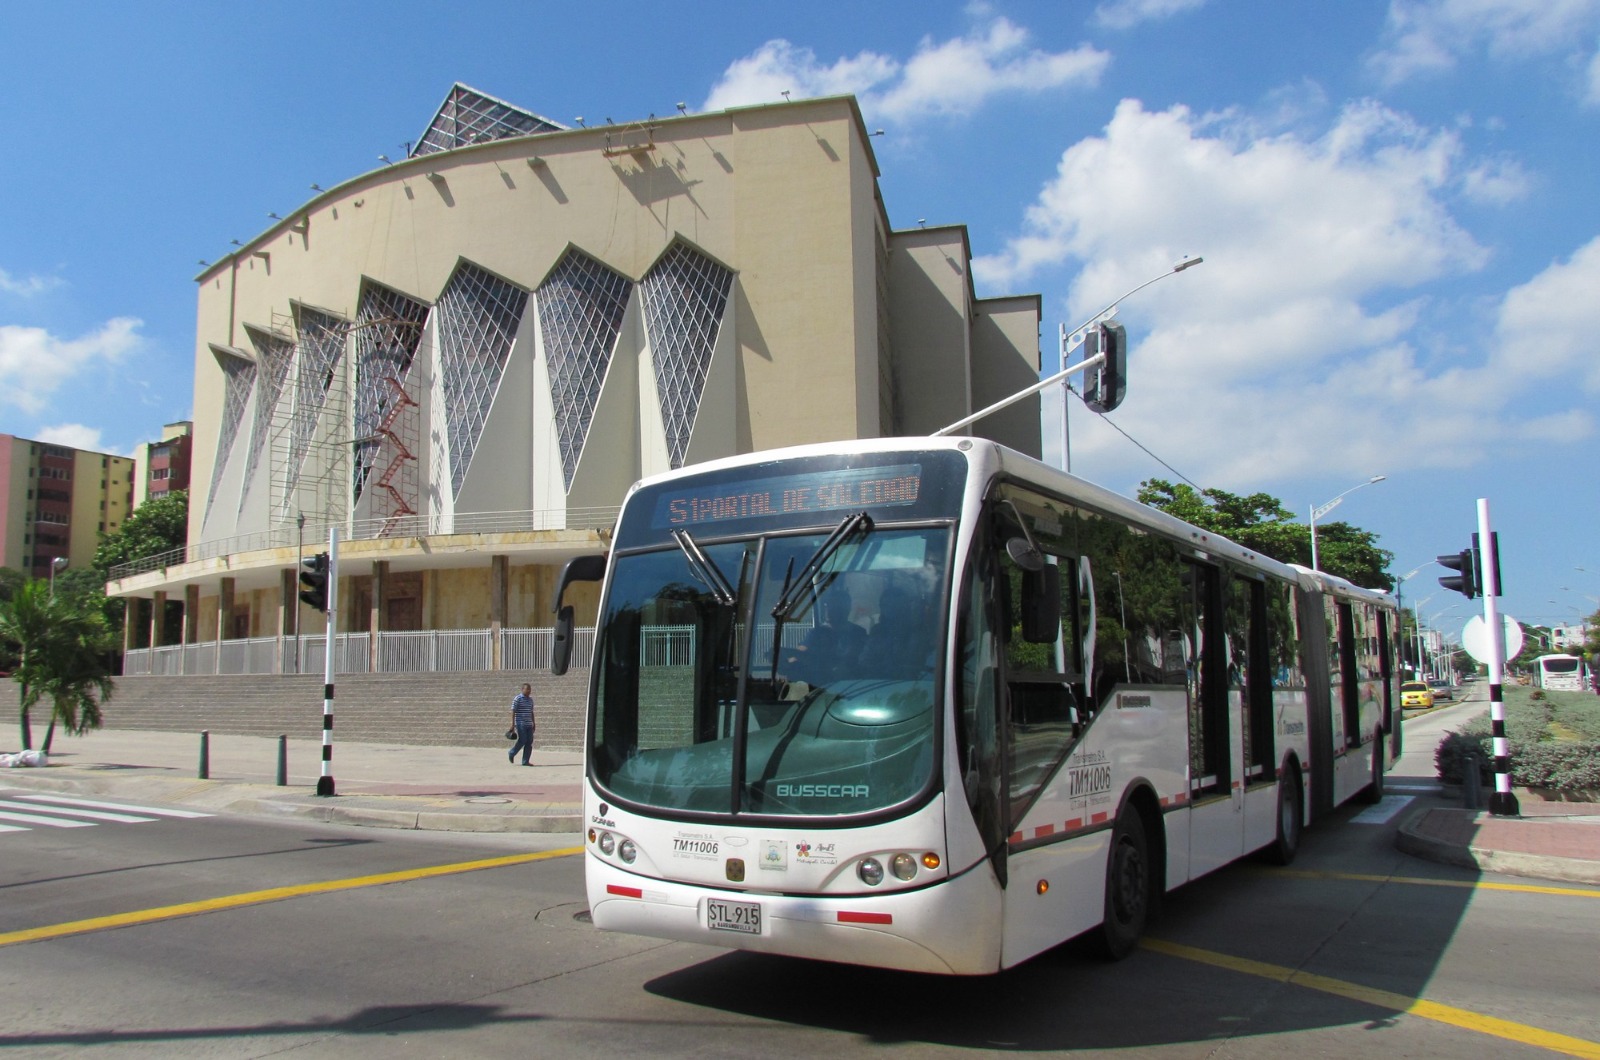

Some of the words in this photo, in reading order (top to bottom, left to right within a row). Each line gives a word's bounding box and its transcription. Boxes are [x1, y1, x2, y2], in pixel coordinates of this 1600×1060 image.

[783, 488, 811, 512] DE
[817, 476, 920, 508] SOLEDAD
[776, 784, 870, 798] BUSSCAR
[1069, 766, 1111, 796] TM11006
[673, 839, 719, 854] TM11006
